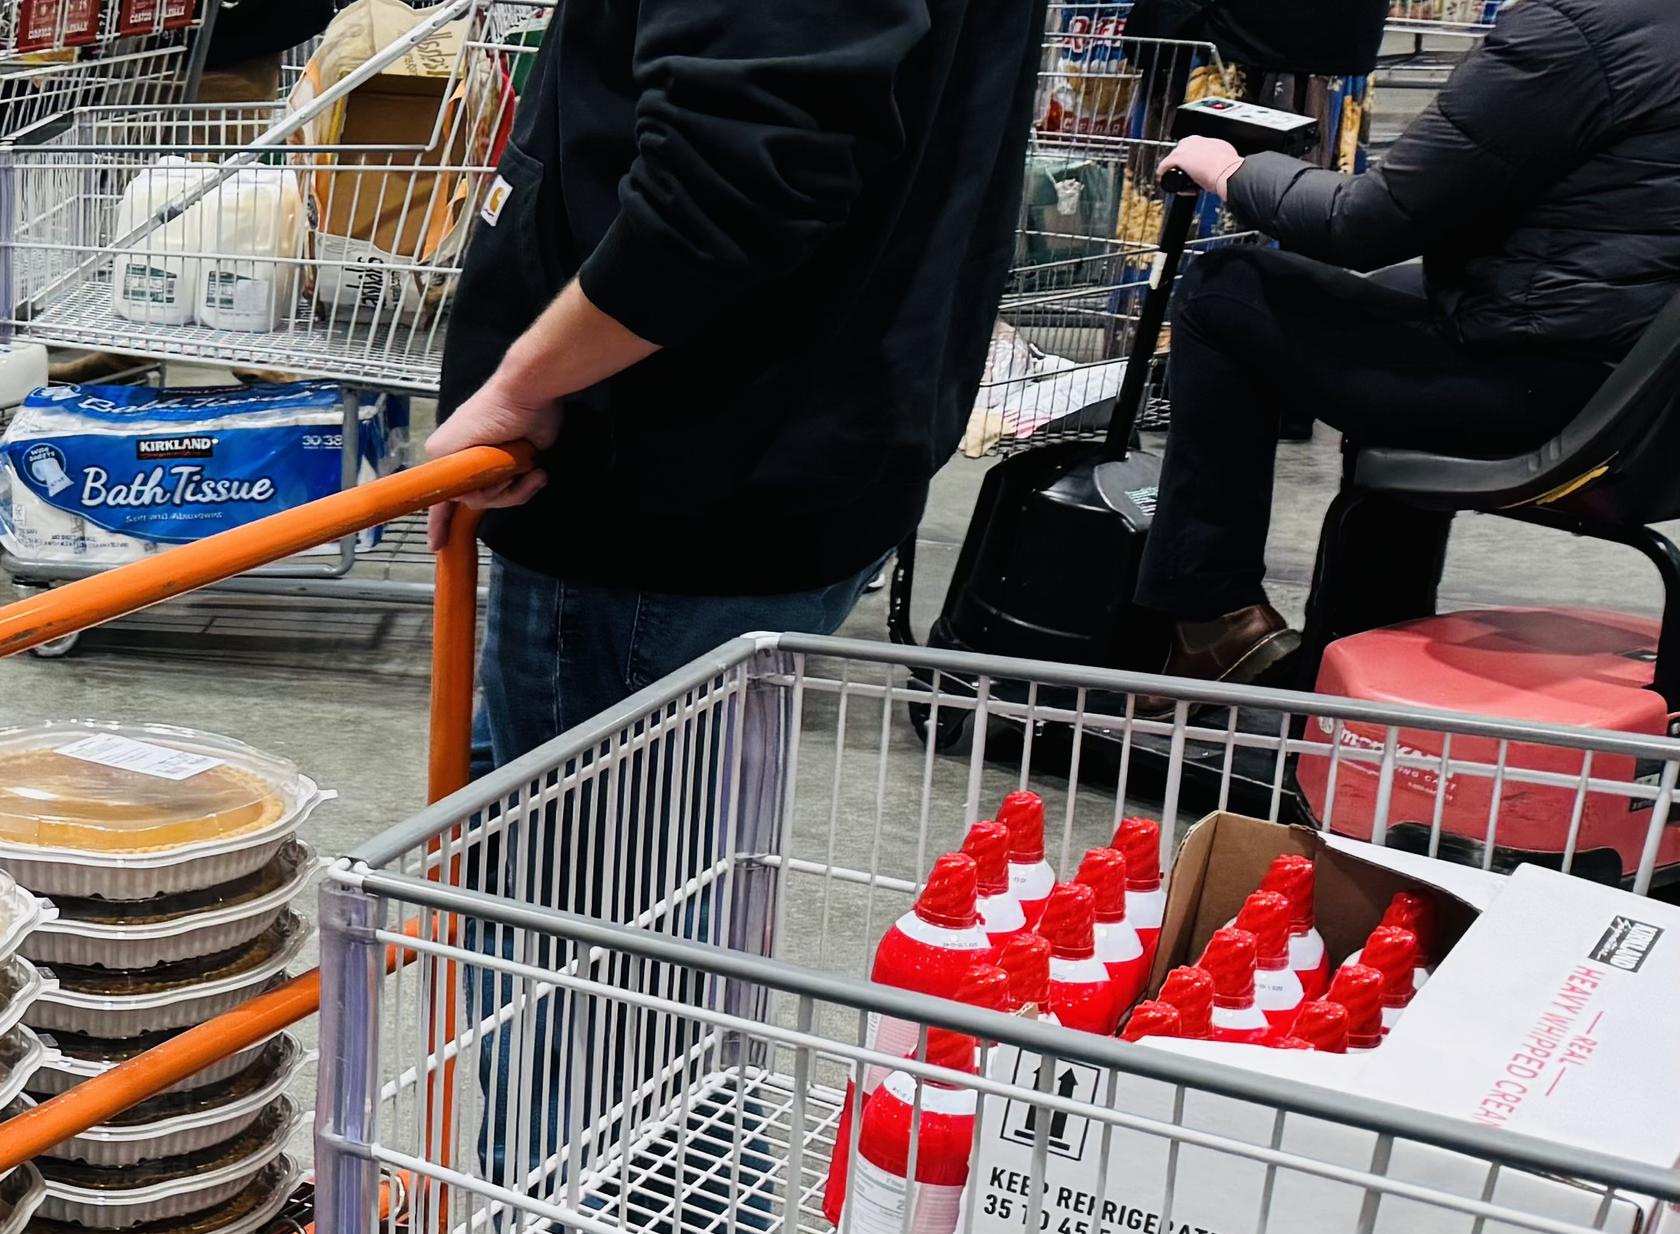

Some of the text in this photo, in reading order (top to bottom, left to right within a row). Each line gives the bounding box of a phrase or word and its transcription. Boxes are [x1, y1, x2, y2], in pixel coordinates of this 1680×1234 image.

[140, 438, 211, 452] KIRKLAND
[81, 466, 275, 506] Bath Tissue
[1610, 923, 1658, 970] KIRKLAND
[1551, 965, 1607, 1015] HEAVY
[1506, 1012, 1576, 1080] WHIPPED
[1559, 1034, 1599, 1066] REAL
[984, 1194, 1013, 1220] 35
